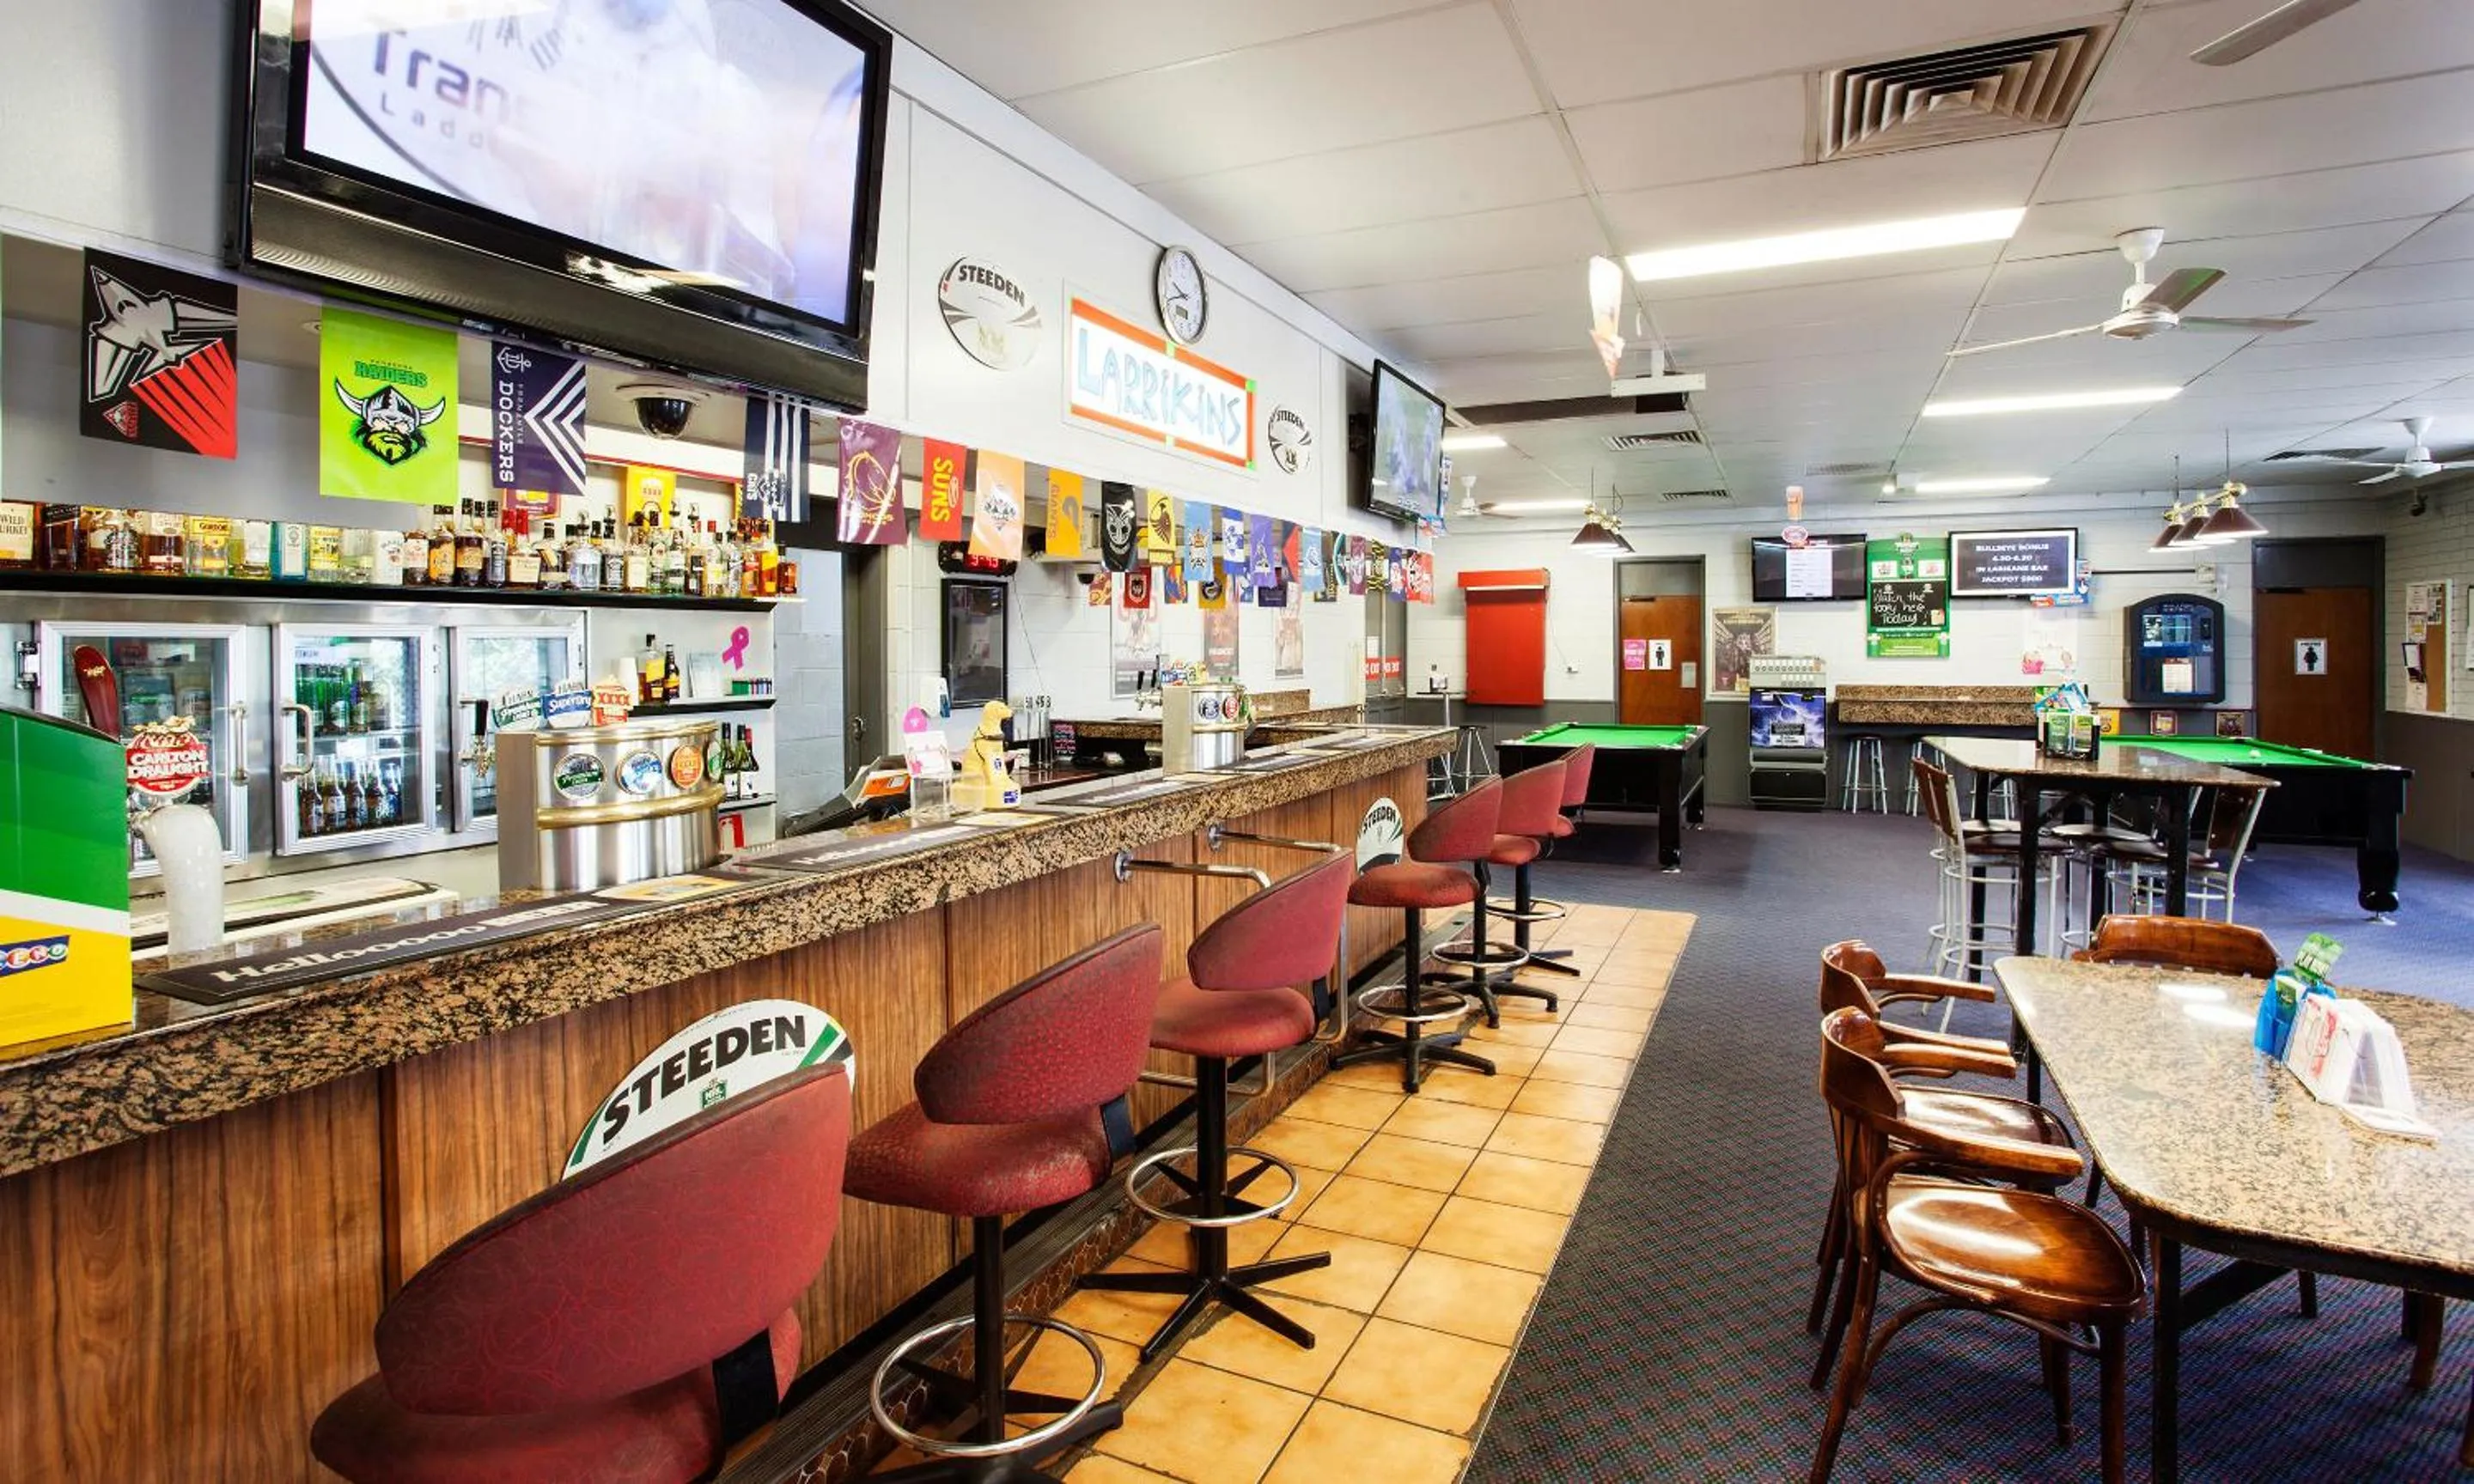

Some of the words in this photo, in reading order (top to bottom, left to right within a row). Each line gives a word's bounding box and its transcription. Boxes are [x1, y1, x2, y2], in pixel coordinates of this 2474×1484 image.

[958, 265, 1026, 307] STEEDEN
[354, 360, 428, 389] RAIDERS
[498, 380, 515, 483] DOCKERS
[930, 457, 954, 522] SUNS
[1907, 591, 1926, 602] the
[128, 761, 209, 779] DRAUGHT
[131, 749, 207, 765] CARLTON
[1362, 806, 1397, 834] STEEDEN
[603, 1015, 807, 1146] STEEDEN
